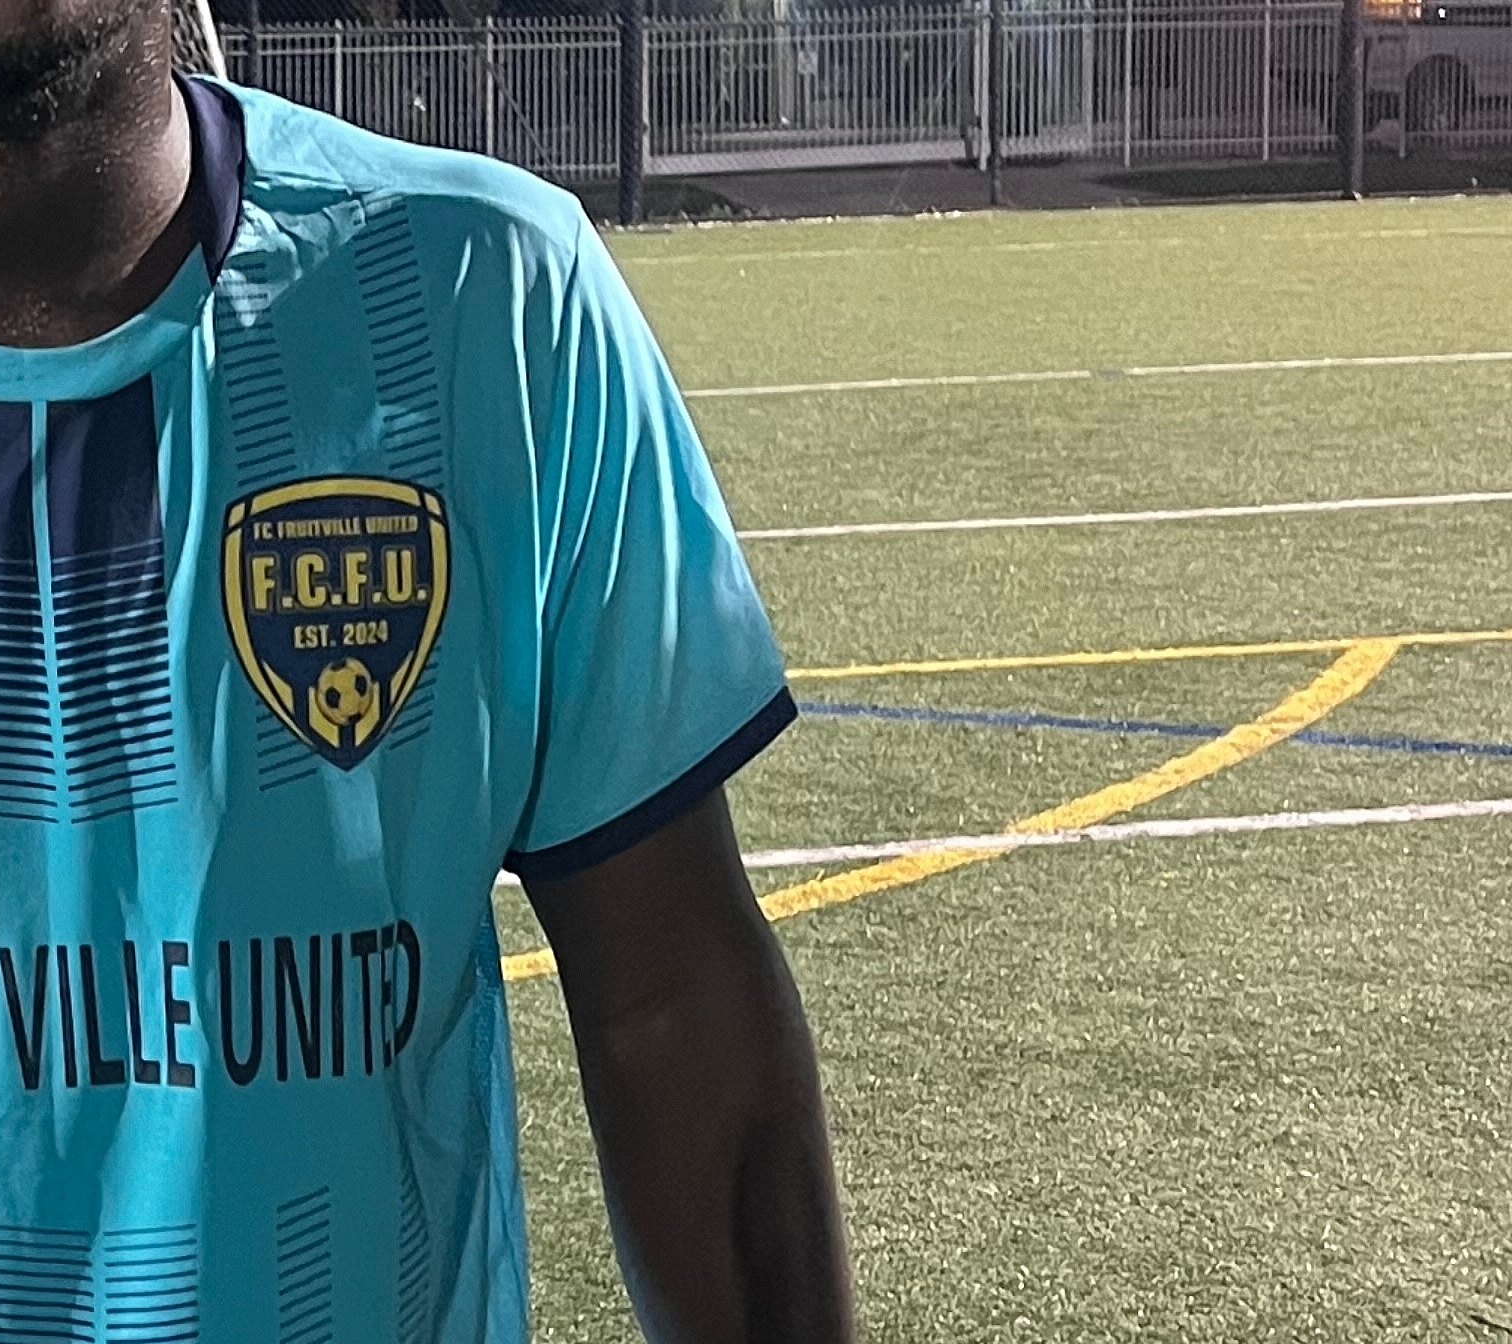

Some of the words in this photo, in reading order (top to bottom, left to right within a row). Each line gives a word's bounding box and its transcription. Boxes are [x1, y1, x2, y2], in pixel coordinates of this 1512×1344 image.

[253, 522, 273, 540] FC
[277, 517, 360, 539] FRUITVILLE
[365, 515, 418, 534] UNITED
[294, 624, 337, 648] EST.
[343, 620, 388, 644] 2024
